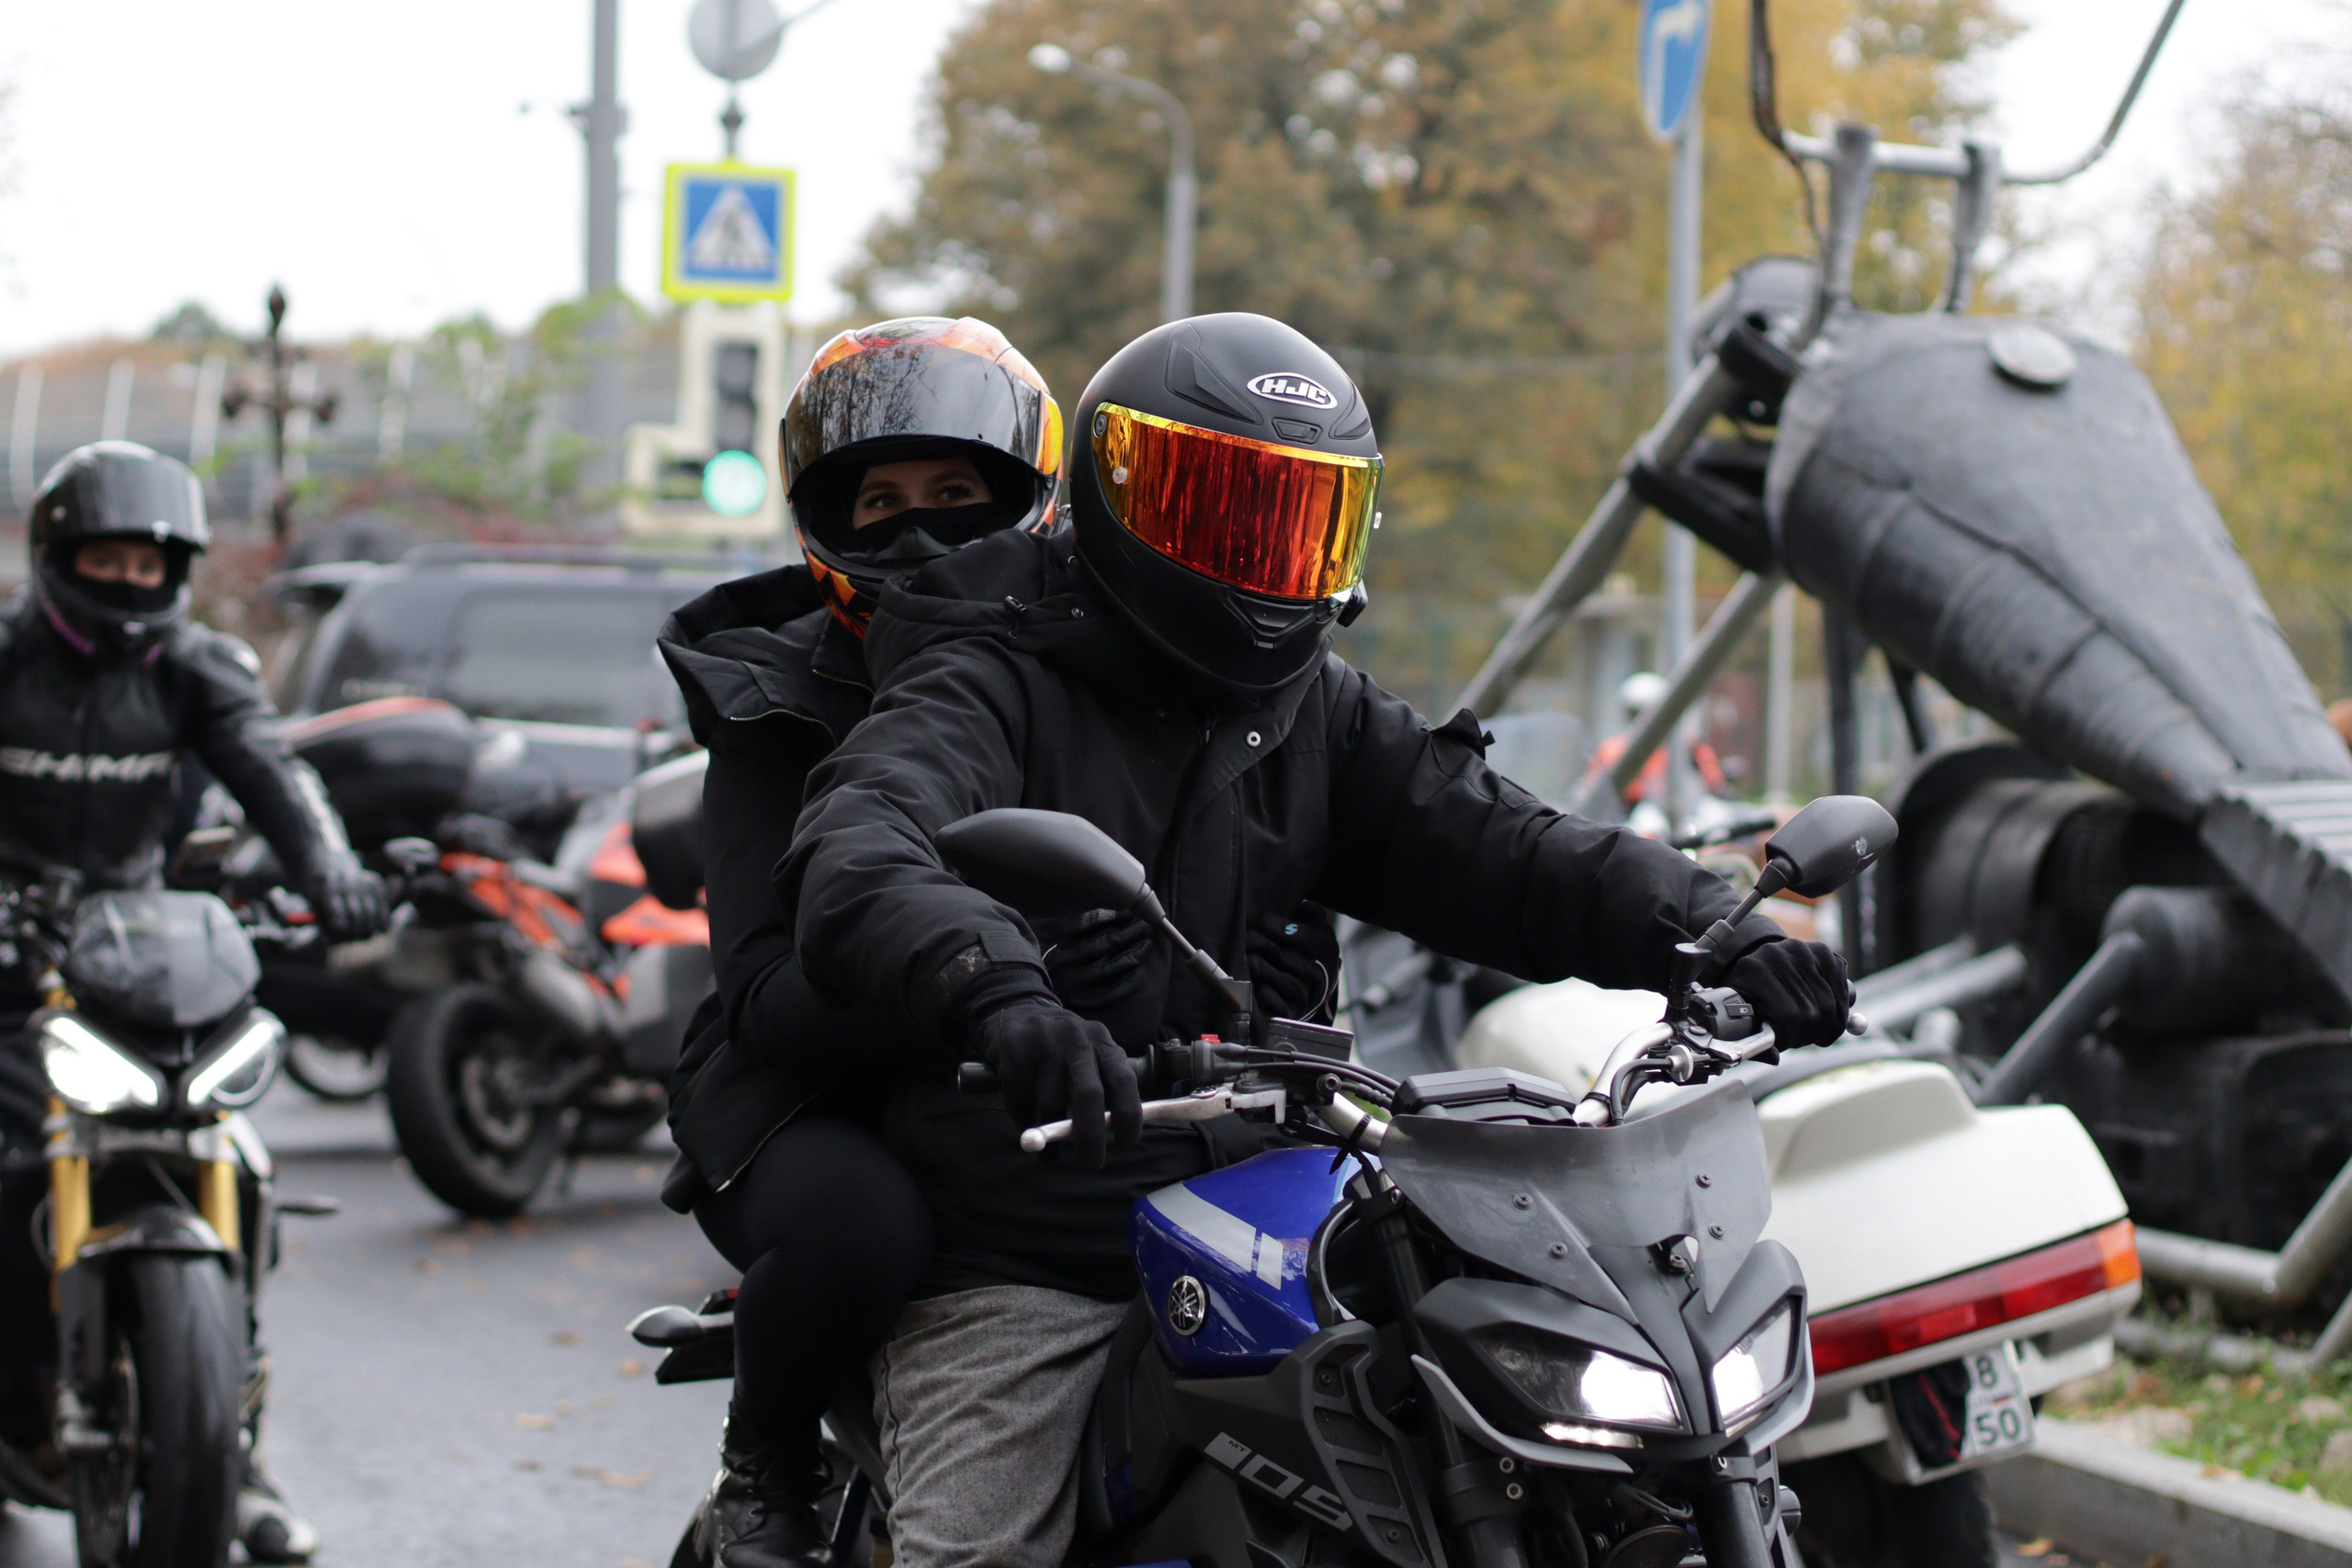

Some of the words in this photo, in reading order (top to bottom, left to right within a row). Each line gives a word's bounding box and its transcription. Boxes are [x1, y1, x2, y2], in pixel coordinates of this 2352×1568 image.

[1261, 378, 1328, 404] HJC
[1976, 1408, 2020, 1445] 50
[1227, 1439, 1248, 1453] MT
